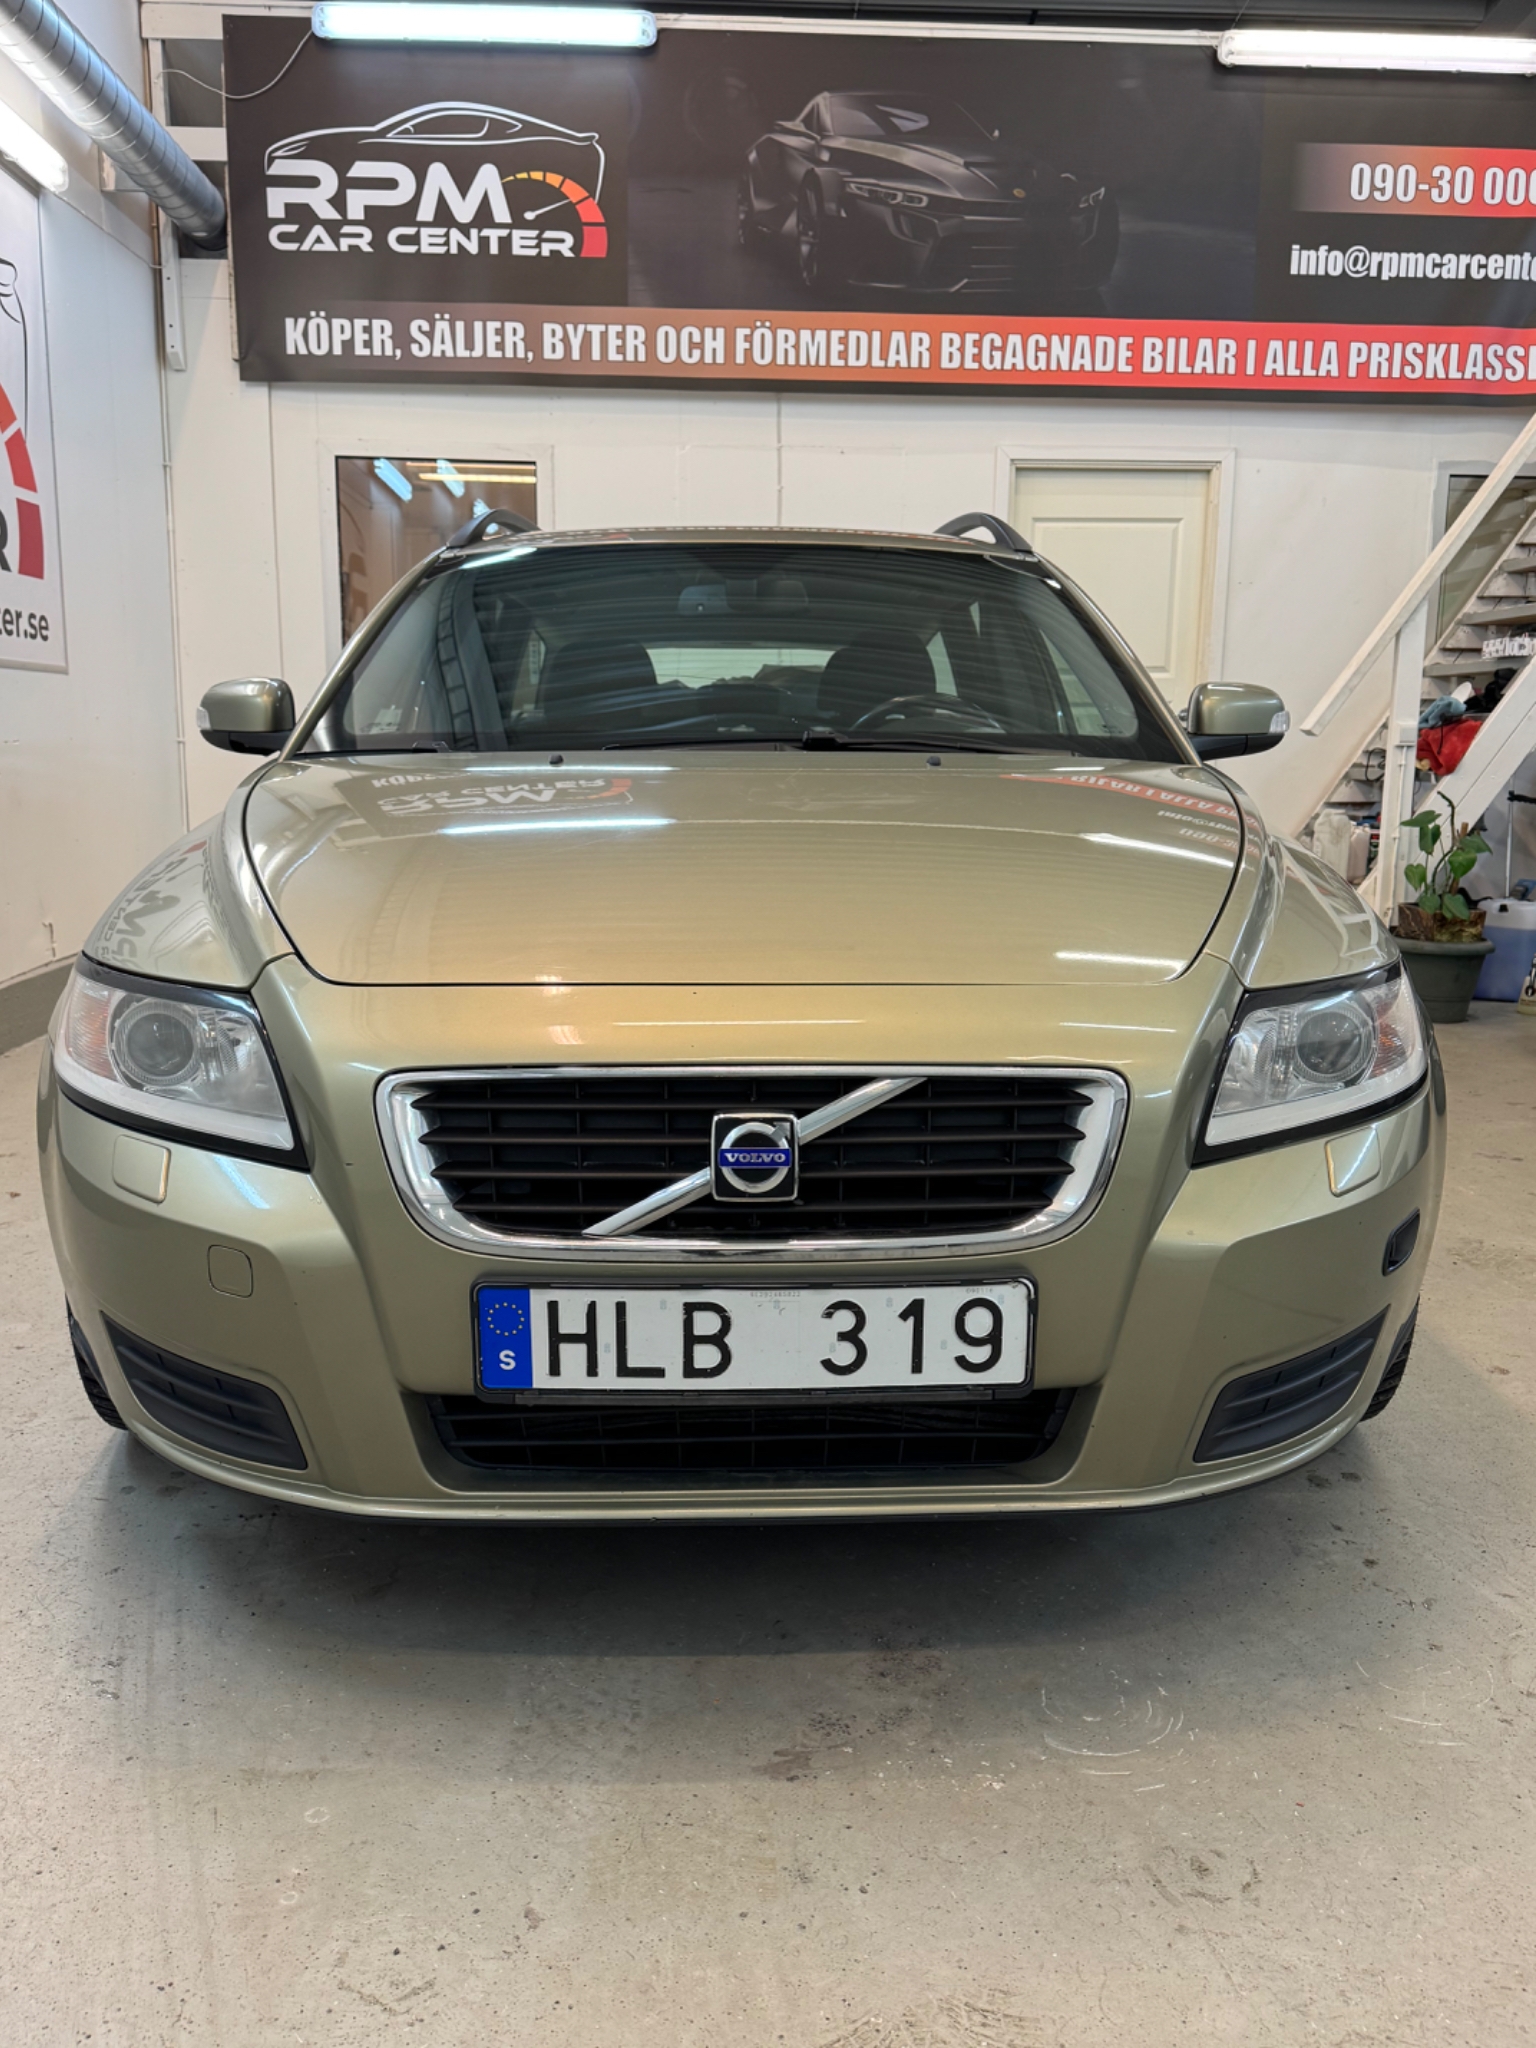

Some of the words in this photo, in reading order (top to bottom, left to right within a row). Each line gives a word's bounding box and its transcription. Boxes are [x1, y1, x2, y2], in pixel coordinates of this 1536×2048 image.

[266, 158, 512, 224] RPM
[1350, 162, 1475, 205] 090-30
[268, 224, 374, 252] CAR
[387, 226, 575, 258] CENTER
[285, 310, 402, 360] KÖPER,
[409, 313, 534, 363] SÄLJER,
[542, 322, 646, 363] BYTER
[655, 324, 726, 365] OCH
[734, 320, 931, 369] FÖRMEDLAR
[940, 332, 1133, 374] BEGAGNADE
[1142, 336, 1237, 375] BILAR
[1245, 339, 1257, 376] I
[1263, 339, 1339, 377] ALLA
[724, 1152, 786, 1163] VOLVO
[547, 1299, 733, 1379] HLB
[820, 1296, 1003, 1375] 319
[499, 1349, 517, 1371] S
